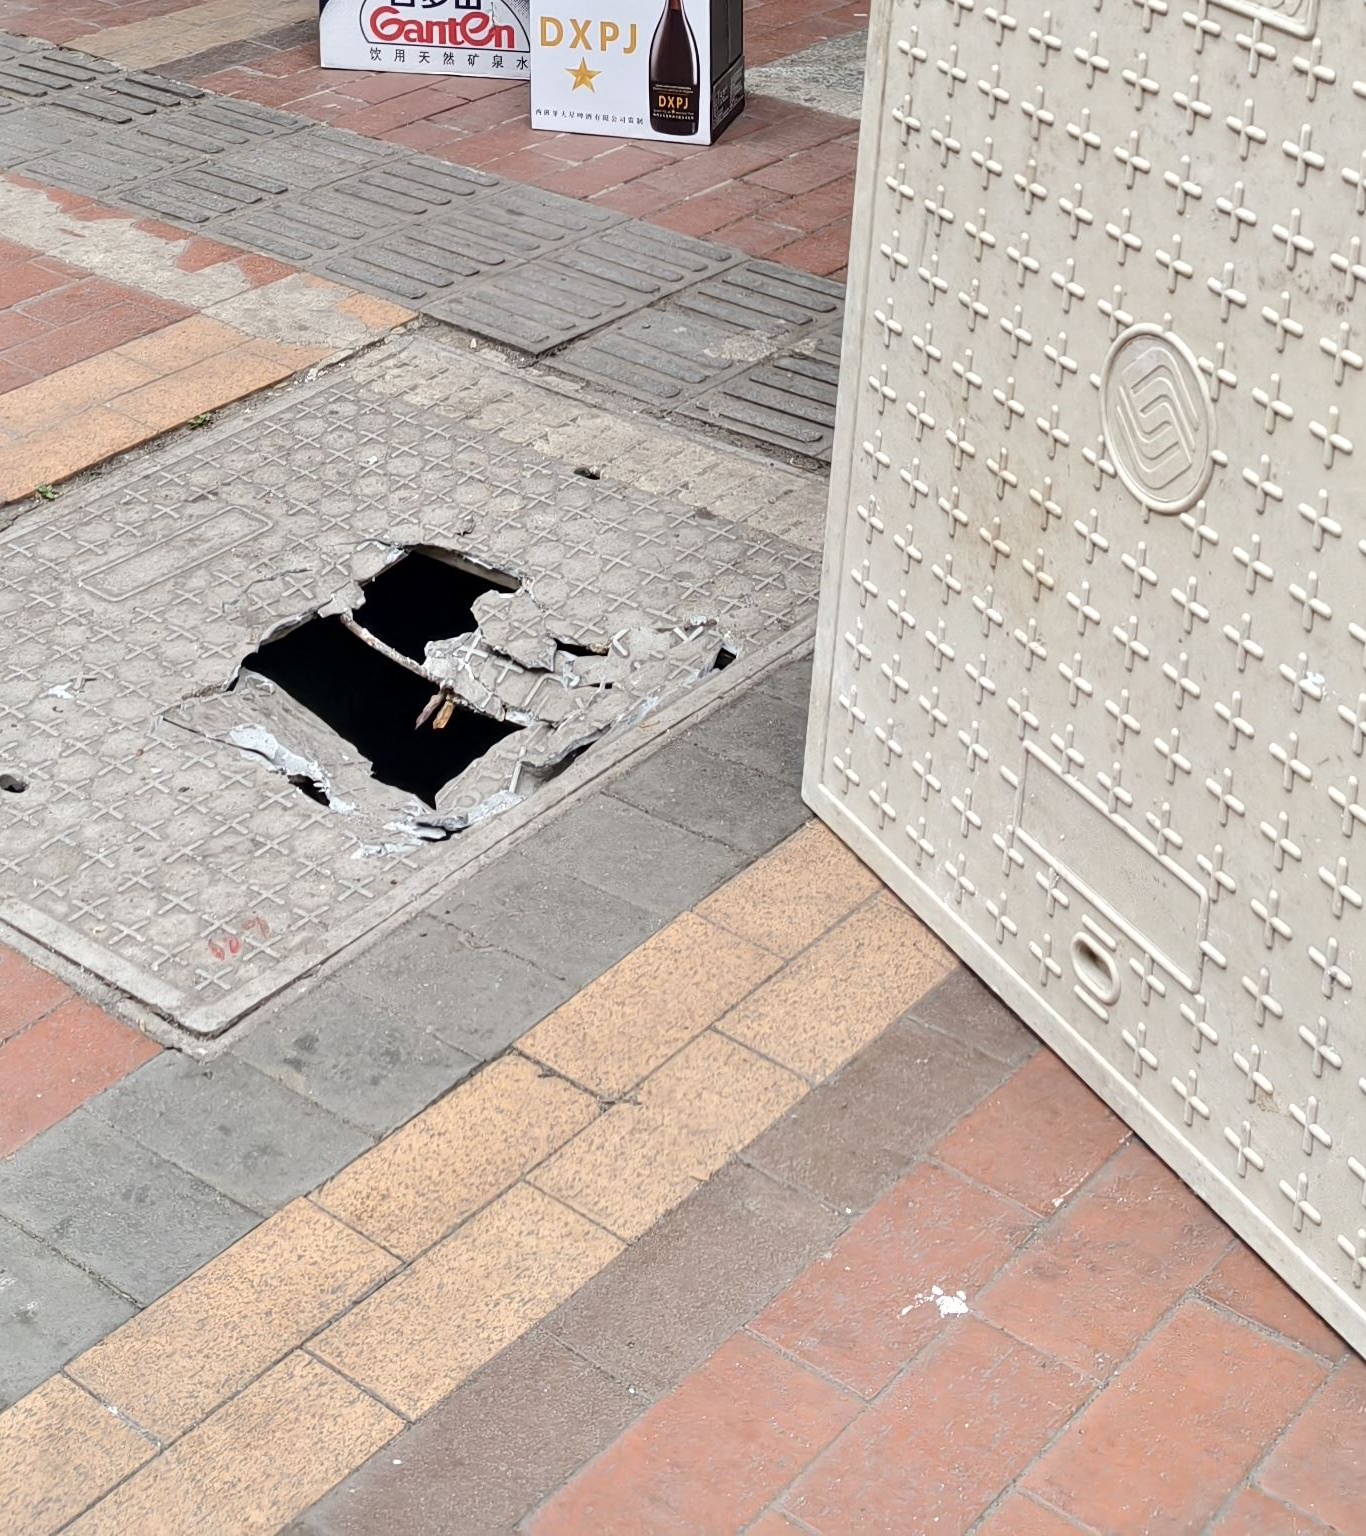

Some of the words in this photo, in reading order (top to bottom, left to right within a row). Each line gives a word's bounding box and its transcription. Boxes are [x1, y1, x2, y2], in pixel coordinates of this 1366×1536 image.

[369, 5, 515, 49] Ganten
[539, 15, 638, 55] DXPJ
[369, 46, 529, 70] 饮用天然矿泉水
[658, 95, 689, 110] DXPJ
